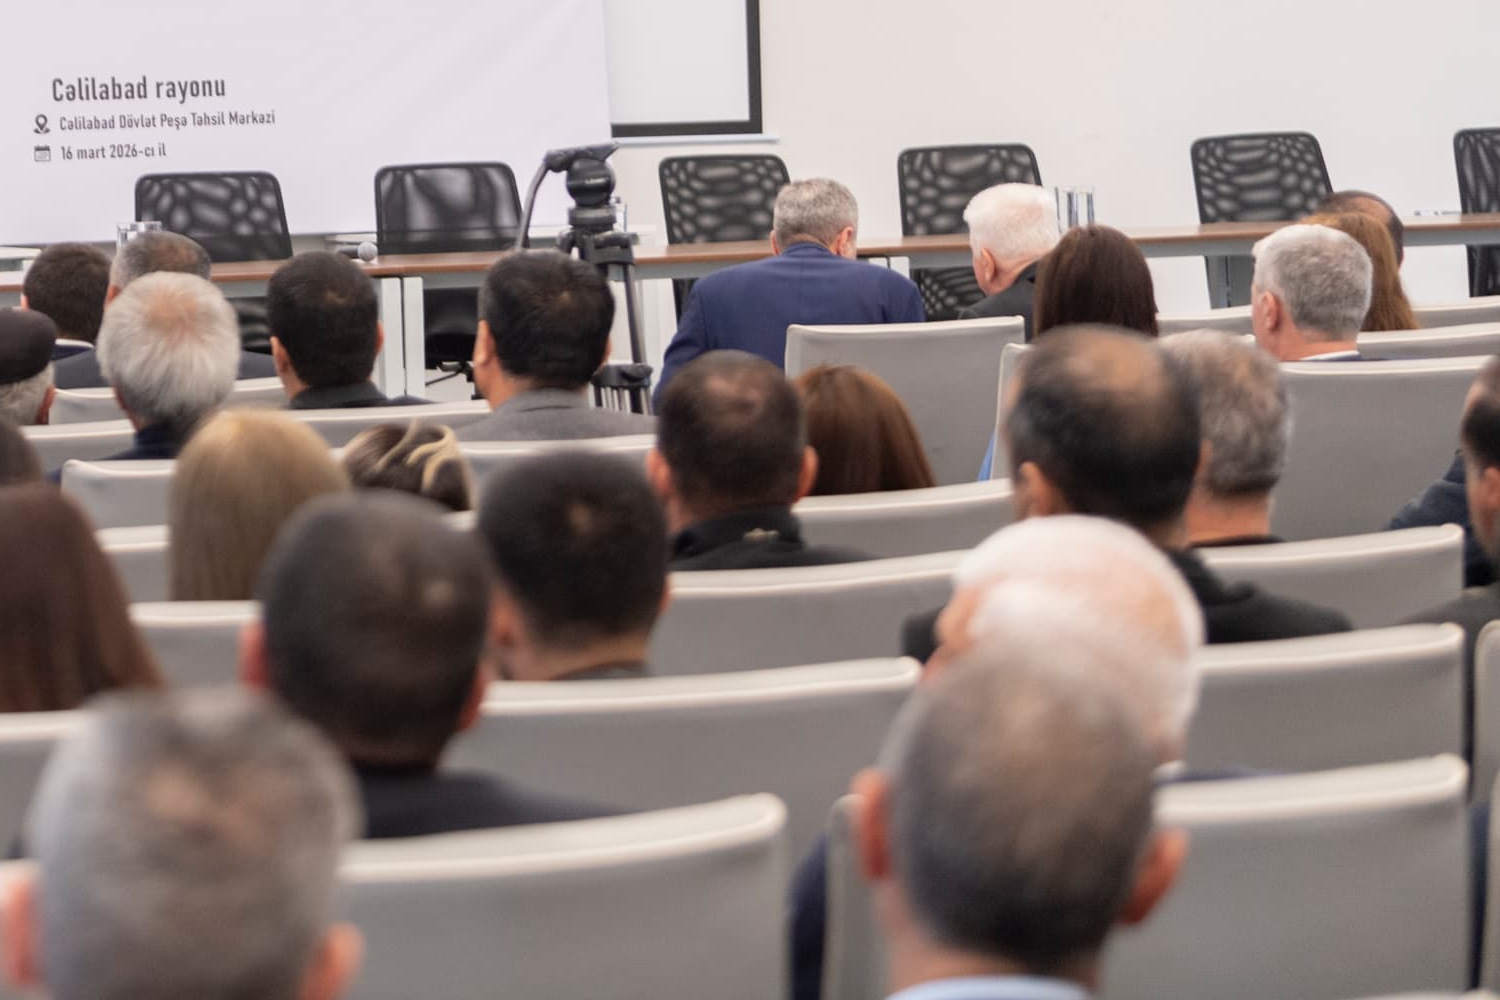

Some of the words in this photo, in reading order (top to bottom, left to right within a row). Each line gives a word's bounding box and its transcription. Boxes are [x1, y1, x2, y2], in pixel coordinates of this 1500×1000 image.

[51, 75, 149, 102] Cəlilabad
[155, 78, 227, 105] rayonu
[59, 115, 115, 131] Cəlilabad
[119, 113, 157, 129] Dövlət
[160, 113, 188, 131] Peşə
[191, 111, 226, 126] Təhsil
[228, 110, 277, 126] Mərkəzi
[60, 146, 73, 161] 16
[77, 145, 106, 160] mart
